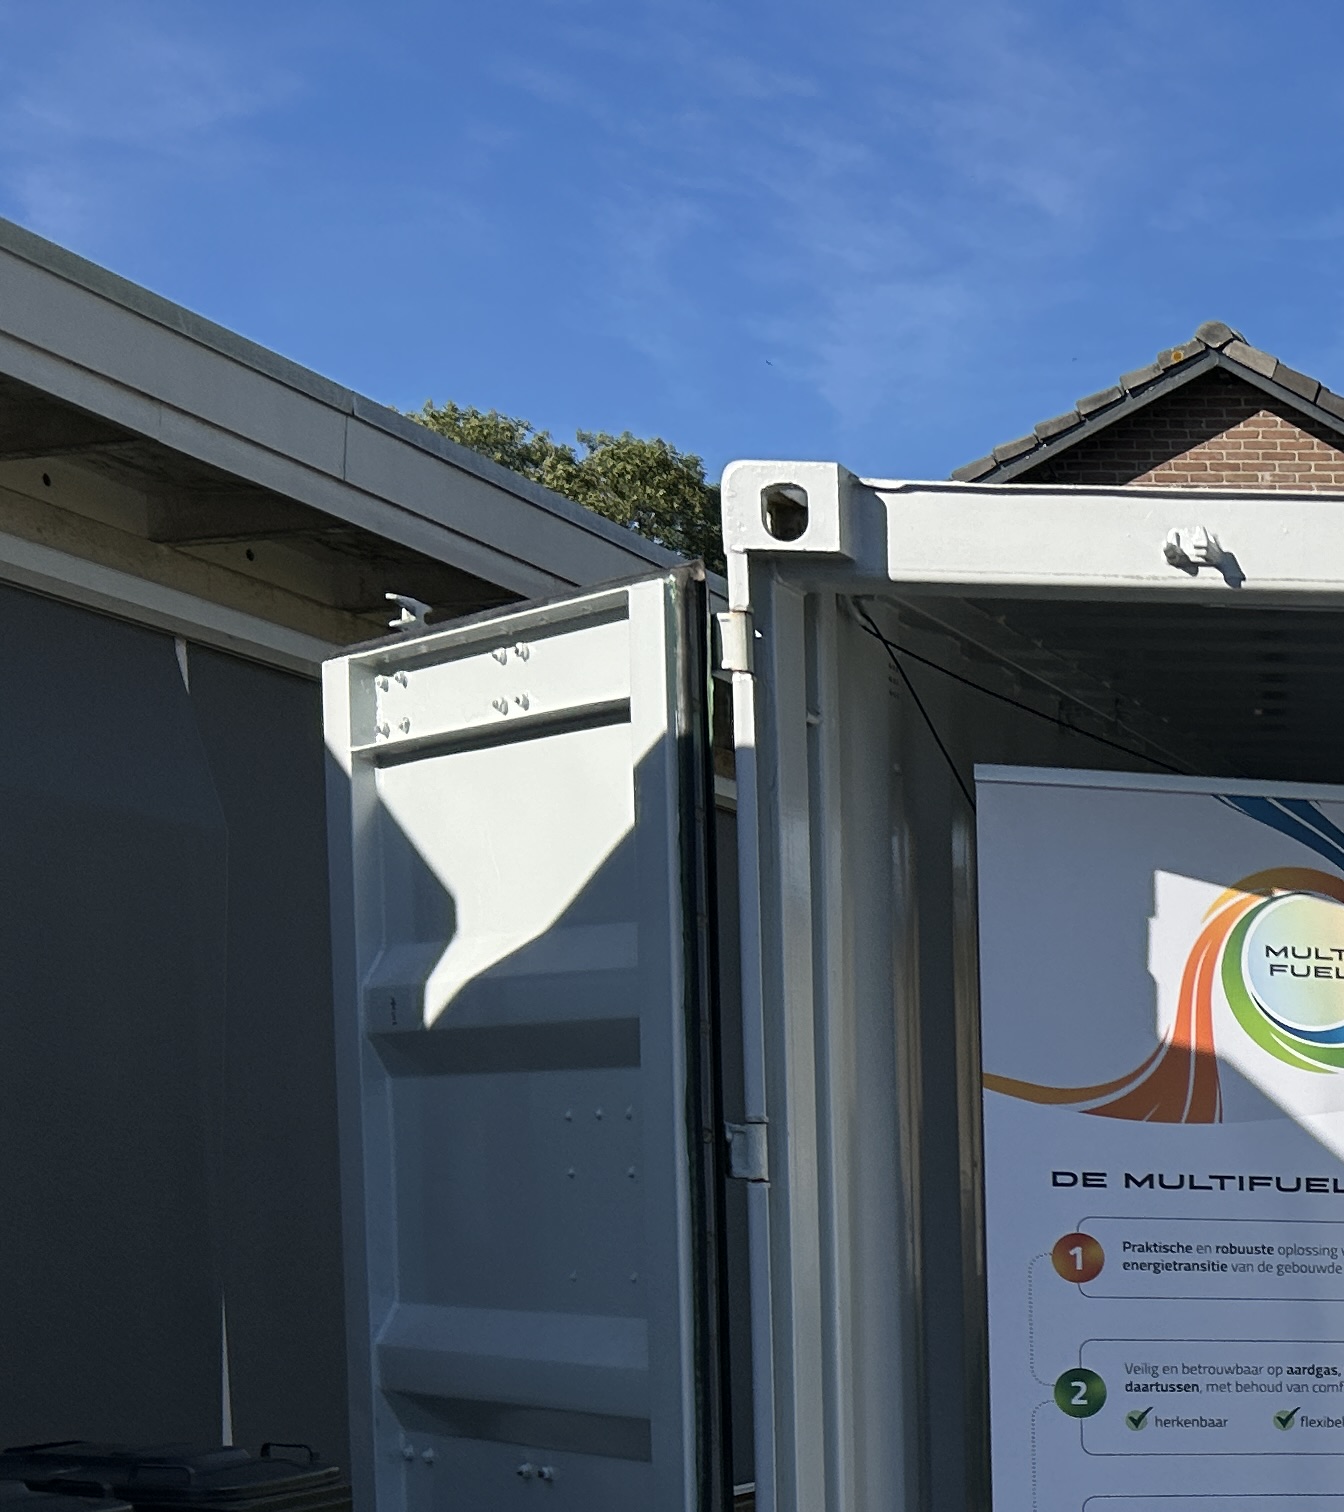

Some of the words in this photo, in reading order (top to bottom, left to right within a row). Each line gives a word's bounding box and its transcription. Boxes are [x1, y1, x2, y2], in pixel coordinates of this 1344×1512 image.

[1051, 1170, 1108, 1189] DE
[1068, 1246, 1083, 1271] 1
[1122, 1241, 1193, 1255] Praktische
[1196, 1244, 1212, 1255] en
[1215, 1242, 1275, 1256] robuuste
[1278, 1243, 1338, 1259] oplossing
[1122, 1259, 1228, 1275] energietransitie
[1231, 1263, 1254, 1273] van
[1257, 1261, 1274, 1274] de
[1276, 1261, 1343, 1277] gebouwde
[1125, 1361, 1159, 1377] Veilig
[1162, 1365, 1178, 1376] en
[1181, 1363, 1263, 1376] betrouwbaar
[1267, 1365, 1284, 1378] op
[1286, 1363, 1342, 1379] aardgas,
[1070, 1381, 1088, 1405] 2
[1125, 1381, 1202, 1395] daartussen,
[1206, 1382, 1232, 1394] met
[1236, 1381, 1283, 1394] behoud
[1286, 1384, 1309, 1394] van
[1155, 1415, 1228, 1428] herkenbaar
[1300, 1415, 1344, 1429] flexibel
